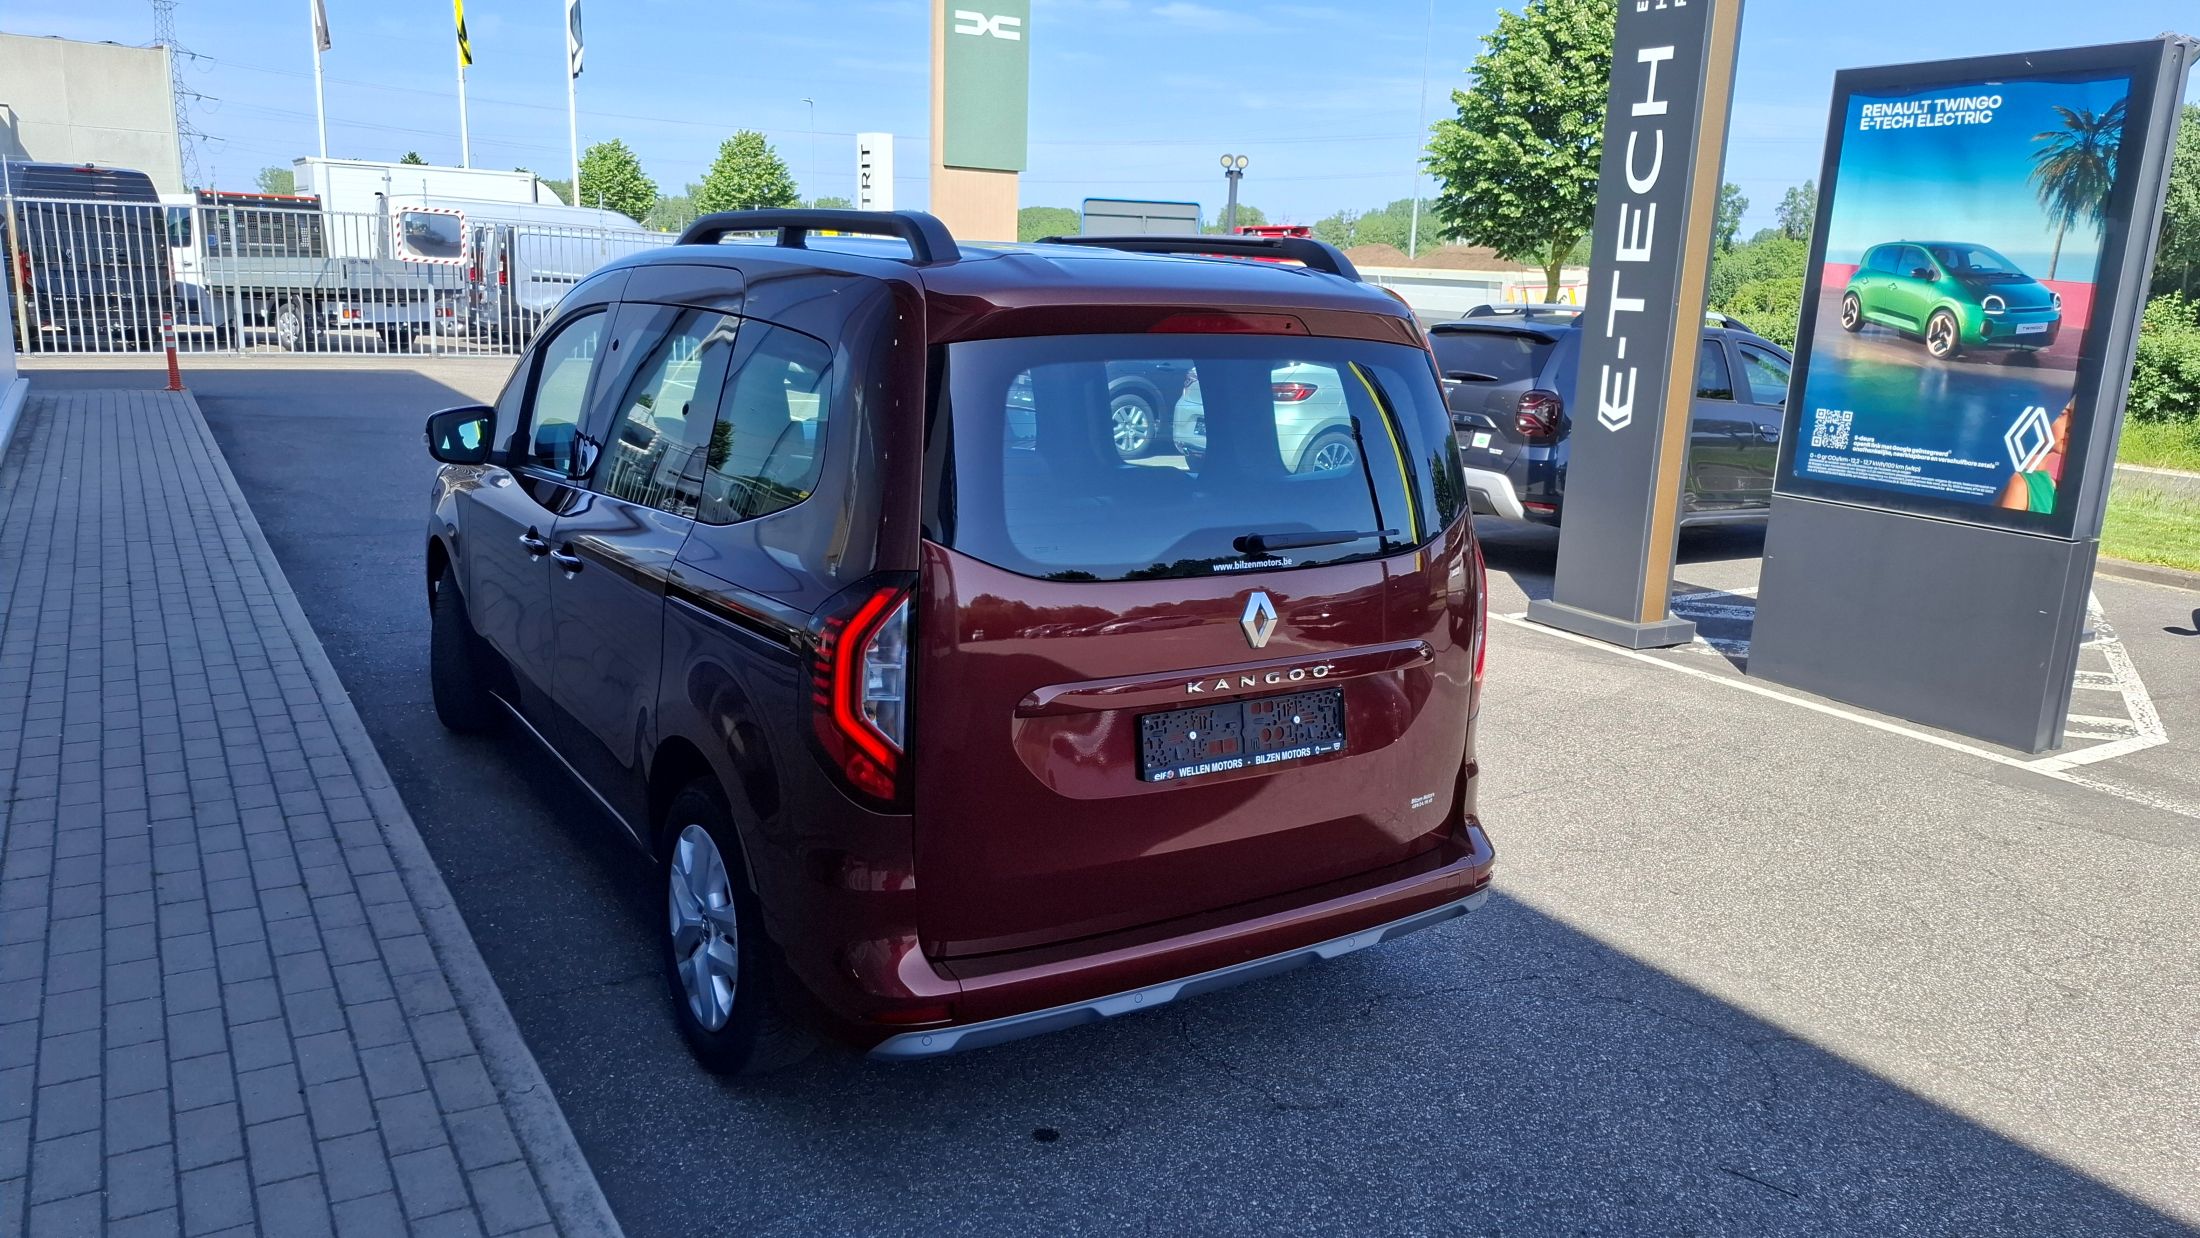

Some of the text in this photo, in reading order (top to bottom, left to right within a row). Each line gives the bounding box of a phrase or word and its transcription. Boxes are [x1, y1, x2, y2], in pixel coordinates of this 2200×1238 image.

[1860, 110, 1993, 130] E-TECH ELECTRIC
[1862, 95, 2002, 117] RENAULT TWINGO
[861, 144, 871, 209] TRIT
[1598, 46, 1674, 432] E-TECH
[1213, 557, 1293, 571] www.bilzenmotors.be
[1187, 665, 1329, 693] KANGOO
[1179, 764, 1211, 777] WELLEN
[1211, 759, 1243, 772] MOTORS
[1255, 752, 1281, 765] BILZEN
[1281, 747, 1311, 760] MOTORS
